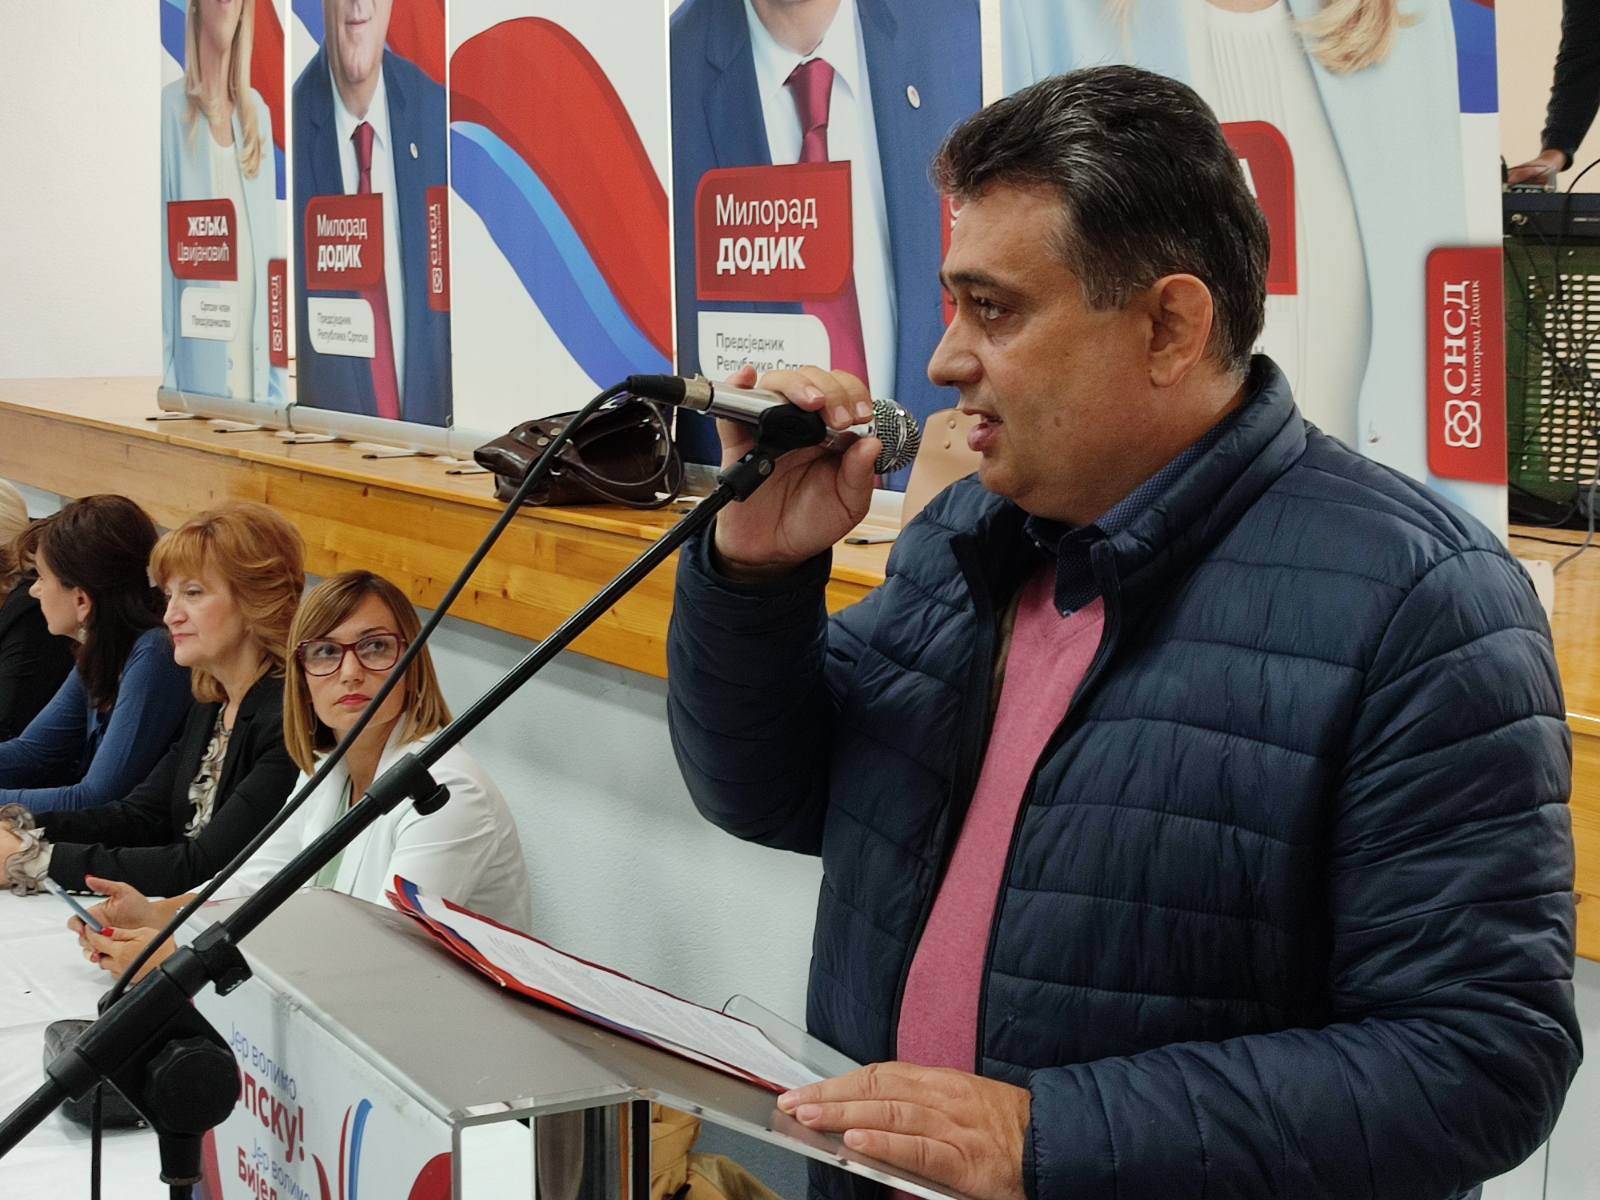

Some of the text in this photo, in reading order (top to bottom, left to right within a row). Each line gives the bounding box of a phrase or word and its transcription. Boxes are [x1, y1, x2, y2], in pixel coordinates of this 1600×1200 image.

[187, 215, 229, 236] ЖЕЉКА
[316, 214, 368, 241] Милорад
[715, 194, 818, 232] Милорад
[317, 244, 362, 272] ДОДИК
[716, 235, 806, 275] ДОДИК
[716, 332, 785, 354] Предсједник
[1443, 280, 1471, 395] СНСД
[1470, 279, 1484, 397] Милорад Додик
[251, 1044, 297, 1101] волимо
